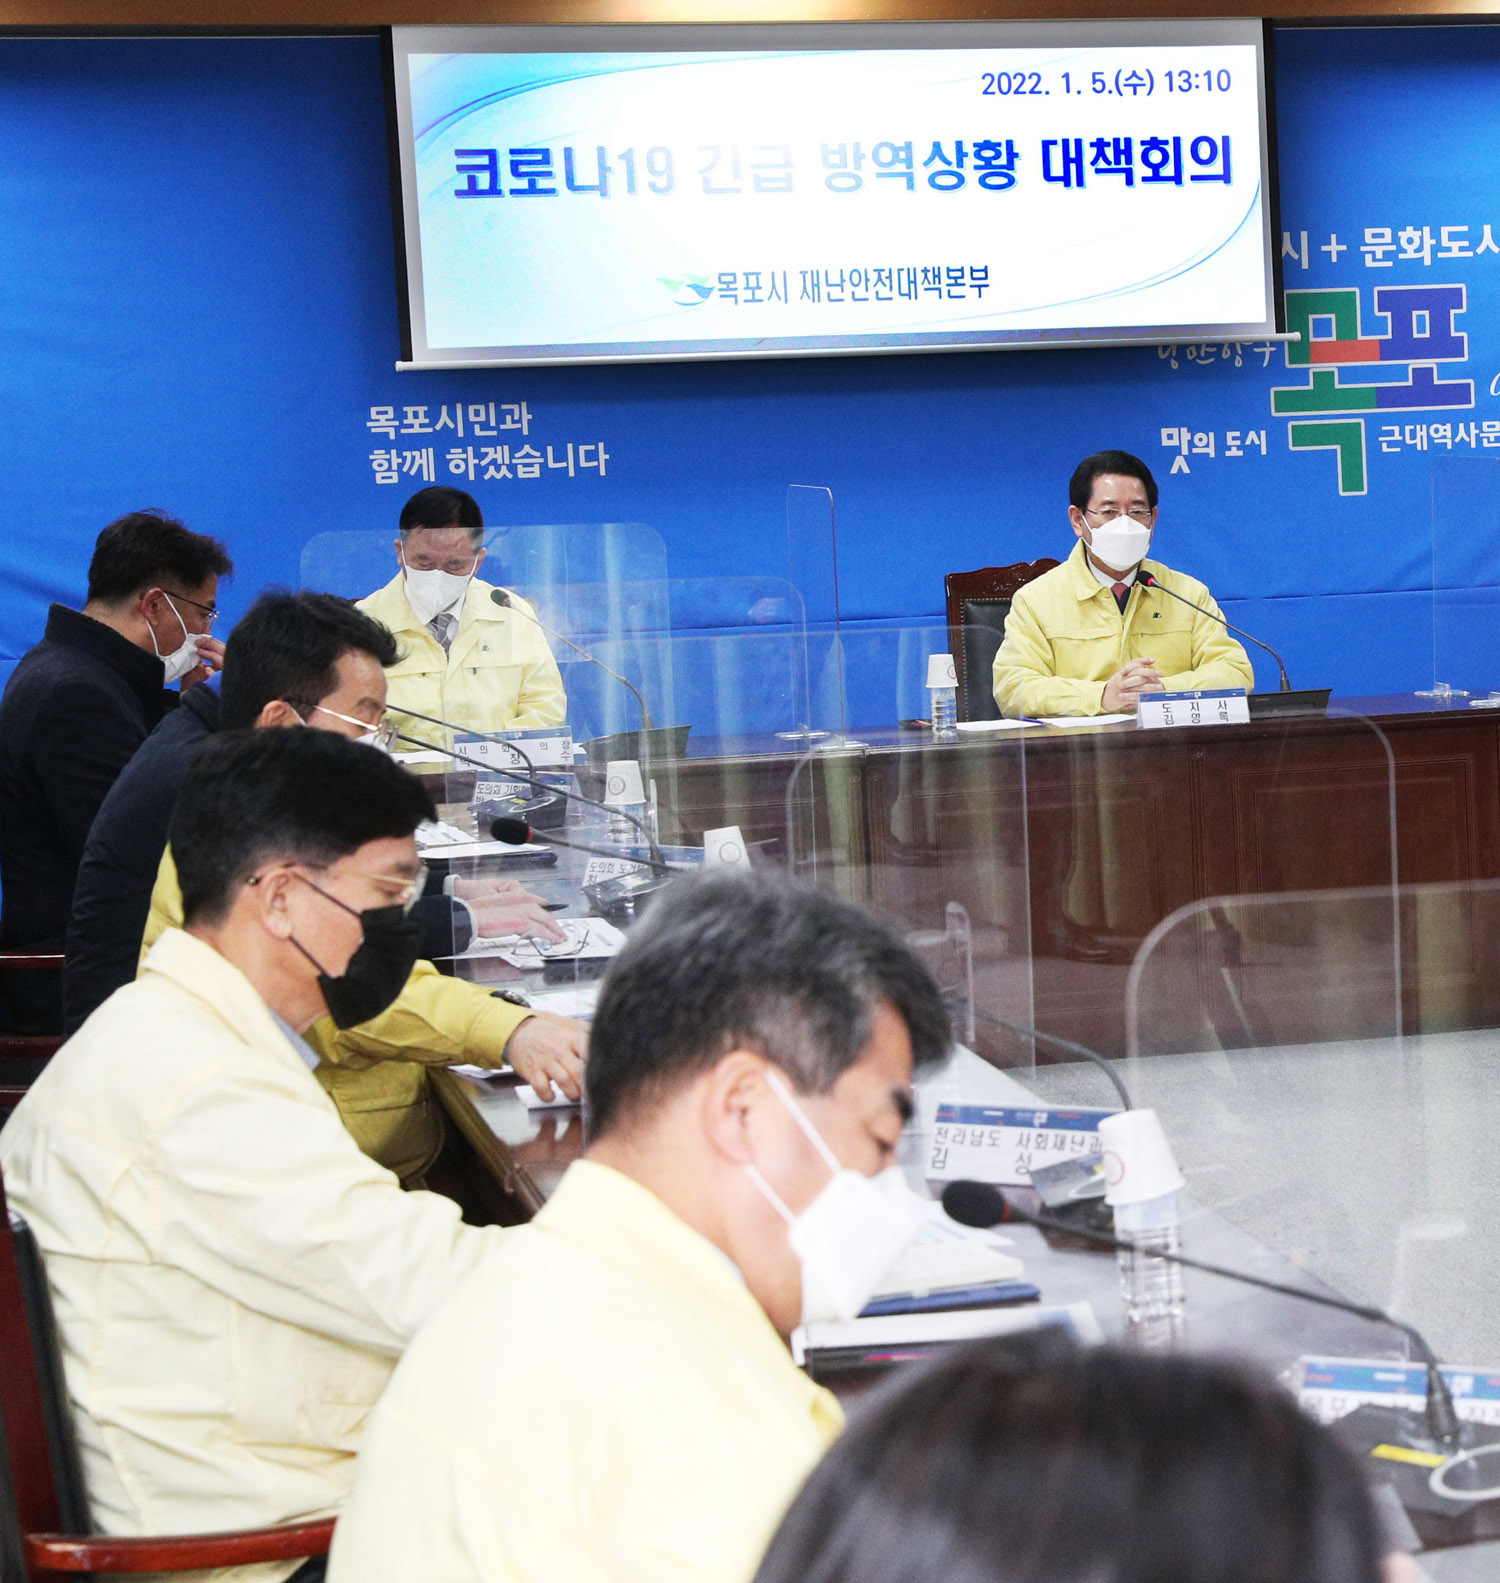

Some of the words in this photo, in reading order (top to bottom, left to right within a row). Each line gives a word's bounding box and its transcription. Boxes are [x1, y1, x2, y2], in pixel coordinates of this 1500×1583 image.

[981, 71, 1050, 95] 2022.
[1061, 71, 1081, 95] 1.
[1091, 68, 1155, 97] 5.(수)
[1164, 68, 1232, 93] 13:10
[454, 146, 675, 198] 코로나19
[698, 143, 795, 196] 긴급
[818, 138, 1021, 195] 방역상황
[1041, 135, 1233, 189] 대책회의
[717, 270, 788, 305] 목포시
[799, 265, 990, 304] 재난안전대책본부
[366, 400, 533, 440] 목포시민과
[368, 447, 436, 485] 함께
[445, 441, 610, 481] 하겠습니다
[1160, 427, 1216, 474] 맛의
[1225, 430, 1267, 456] 도시
[477, 783, 501, 795] 도의회
[934, 1126, 1002, 1148] 전라남도
